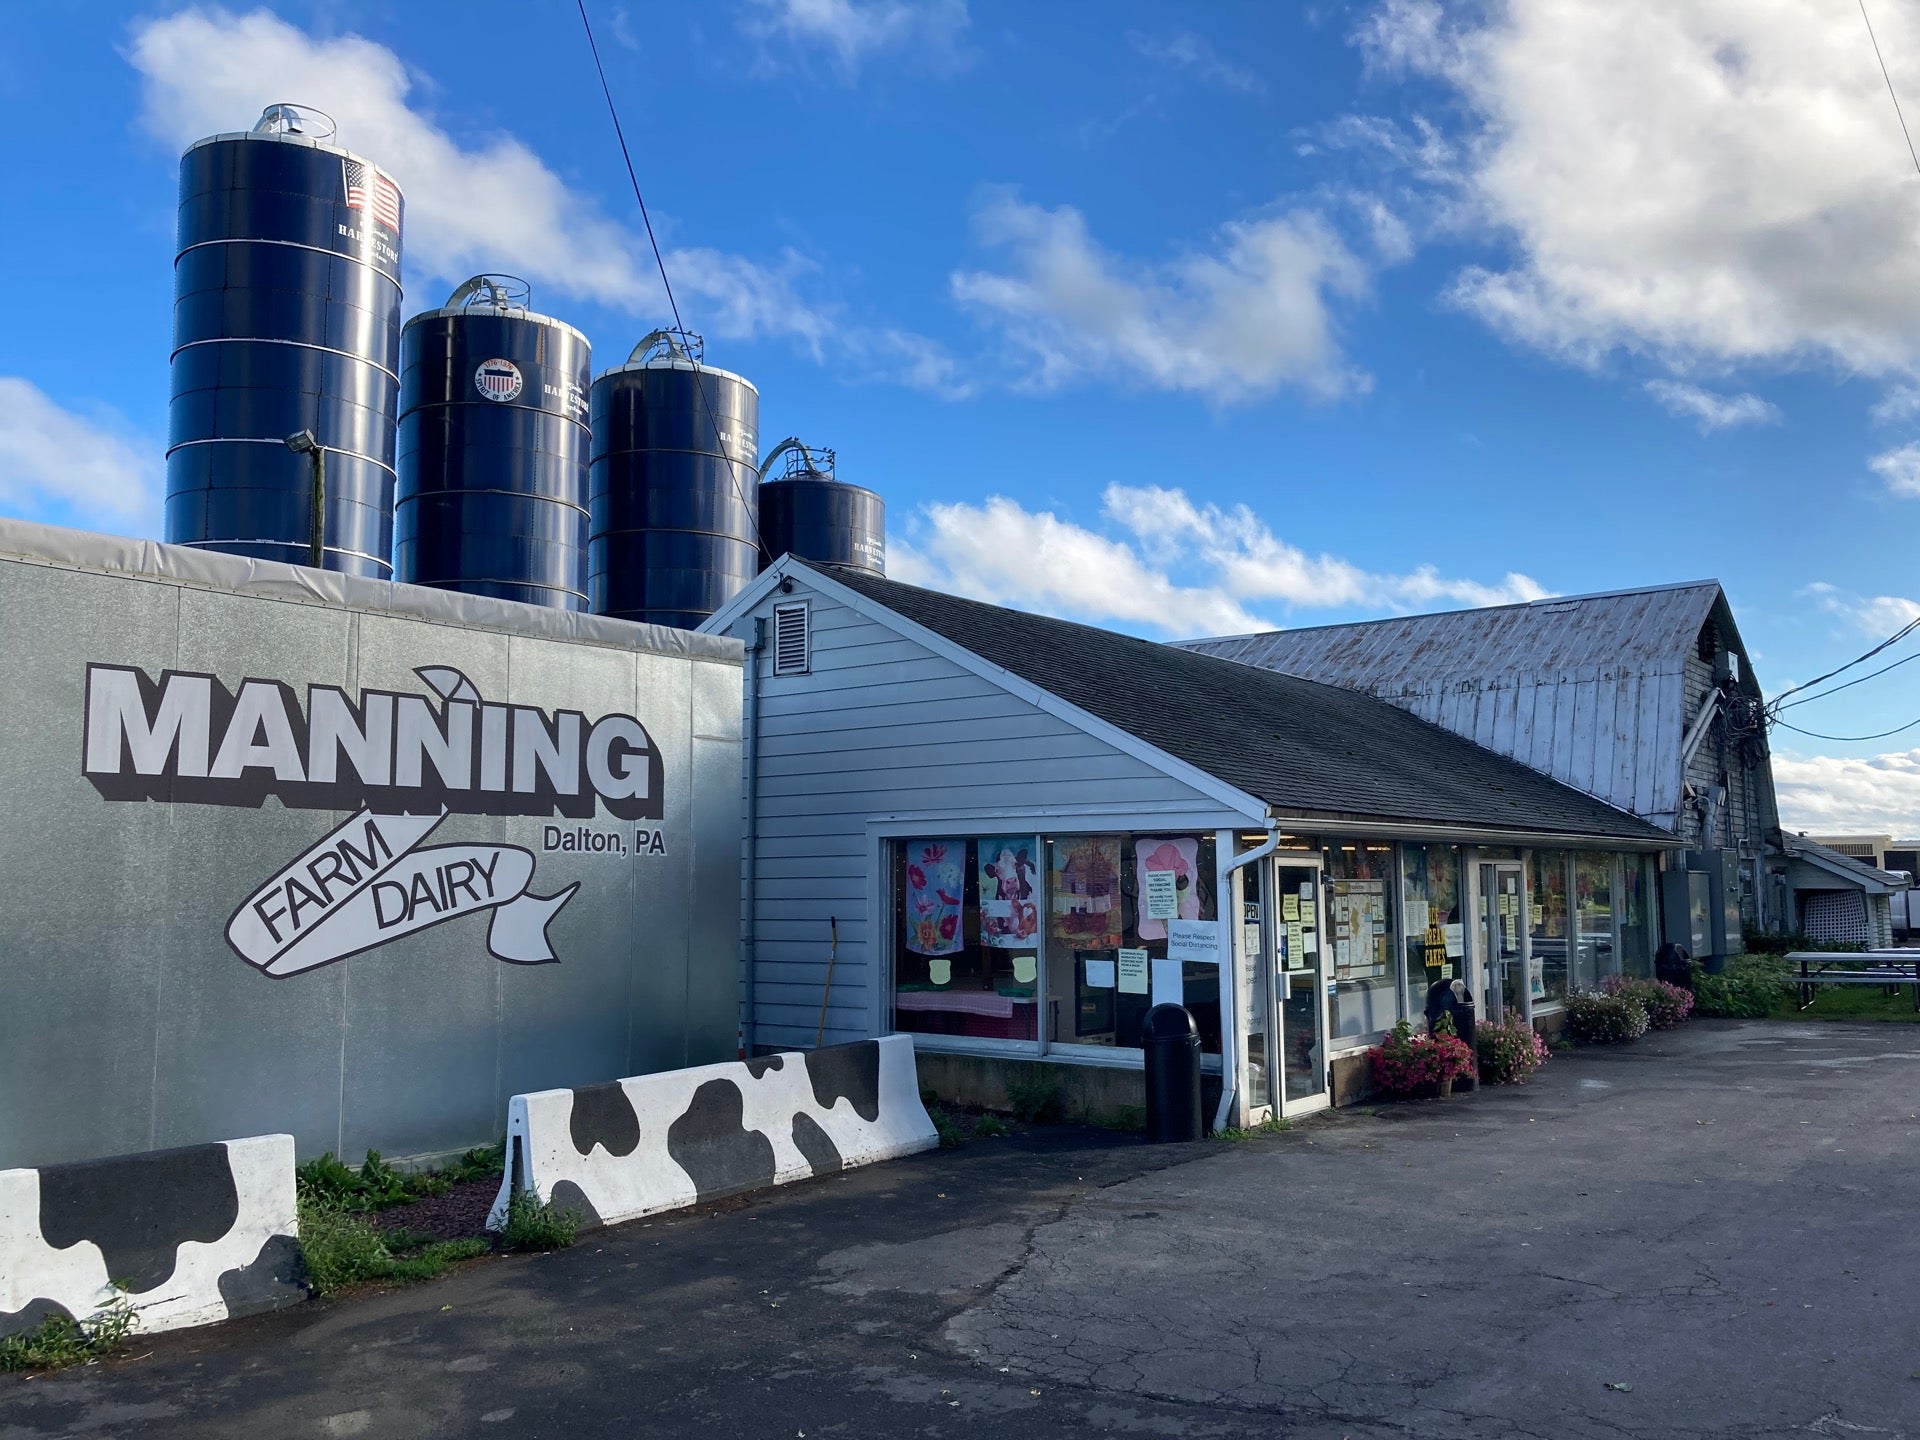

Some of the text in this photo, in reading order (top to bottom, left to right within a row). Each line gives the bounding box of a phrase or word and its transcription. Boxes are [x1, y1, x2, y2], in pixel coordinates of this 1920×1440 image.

[338, 224, 399, 264] HARESTORE
[492, 393, 501, 401] OF
[82, 662, 664, 820] MANNING
[543, 825, 667, 858] Dalton, PA
[252, 821, 393, 944] FARM
[371, 851, 500, 930] DAIRY
[1428, 907, 1440, 925] ICE
[1170, 940, 1218, 951] Social Distancing
[1172, 932, 1216, 941] Please Respect
[1424, 927, 1446, 947] CREAM
[1425, 948, 1446, 968] CAKES
